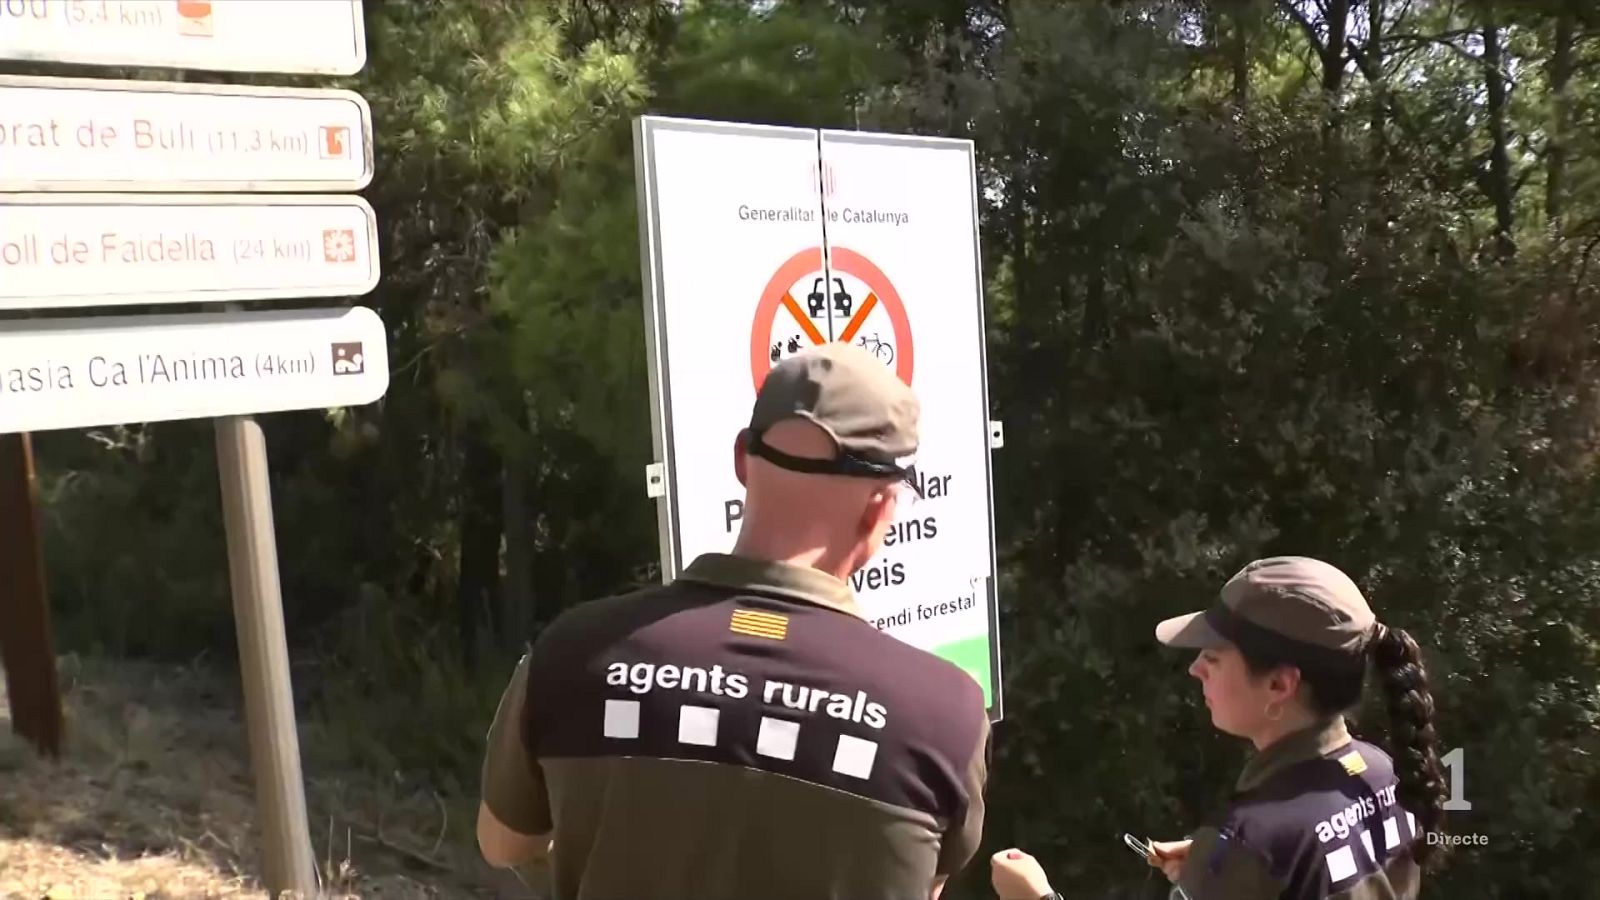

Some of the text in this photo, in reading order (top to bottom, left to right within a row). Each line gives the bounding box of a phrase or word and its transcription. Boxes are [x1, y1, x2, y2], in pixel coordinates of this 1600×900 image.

[76, 119, 117, 148] de
[269, 129, 308, 154] km)
[738, 204, 815, 222] Generalitat
[842, 207, 909, 226] Catalunya
[50, 232, 89, 265] de
[100, 232, 217, 265] Faidella
[273, 238, 311, 263] km)
[0, 351, 315, 393] asia Ca l'Anima (4km)
[869, 592, 976, 632] endi forestal
[606, 662, 888, 730] agents rurals
[1315, 796, 1376, 843] agents
